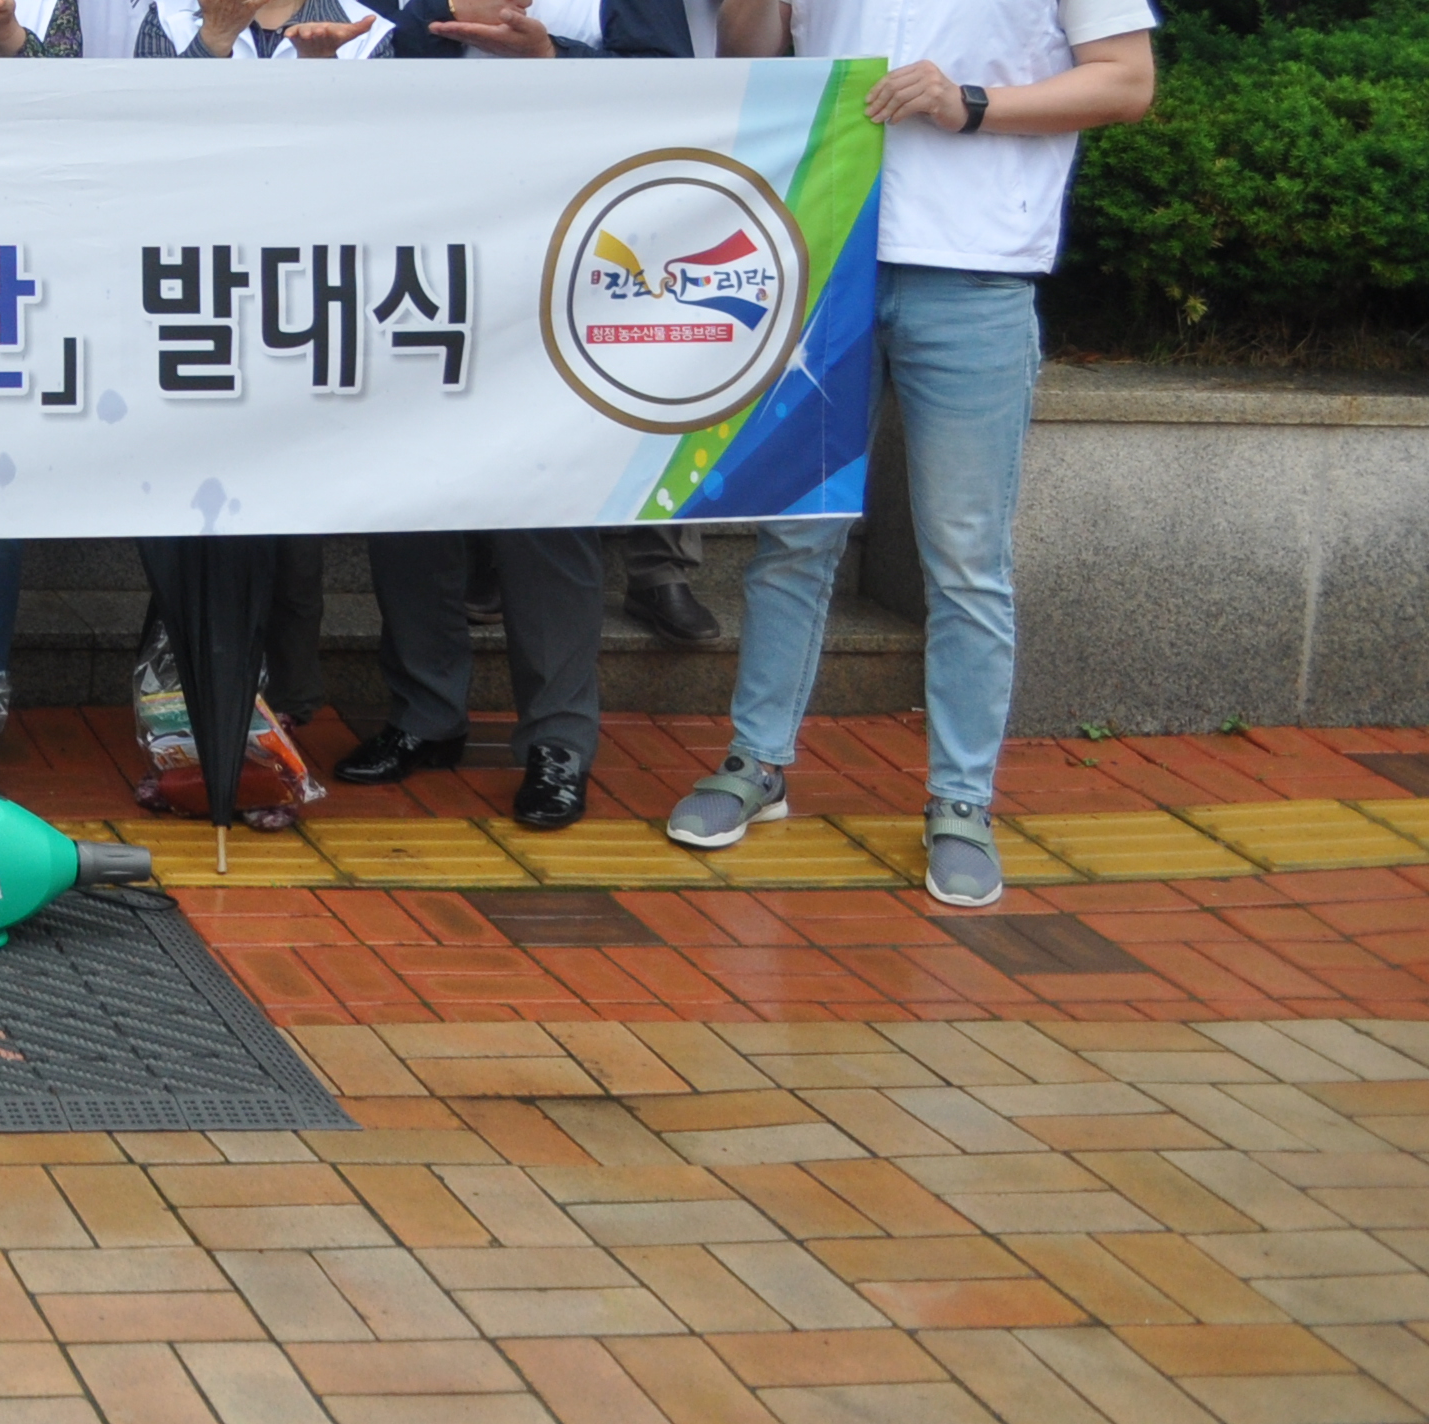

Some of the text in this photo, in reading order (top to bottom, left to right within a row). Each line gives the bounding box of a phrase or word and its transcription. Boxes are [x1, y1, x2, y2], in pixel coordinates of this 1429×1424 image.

[142, 243, 469, 391] 발대식
[592, 326, 729, 342] 청정 농수산물 공동브랜드
